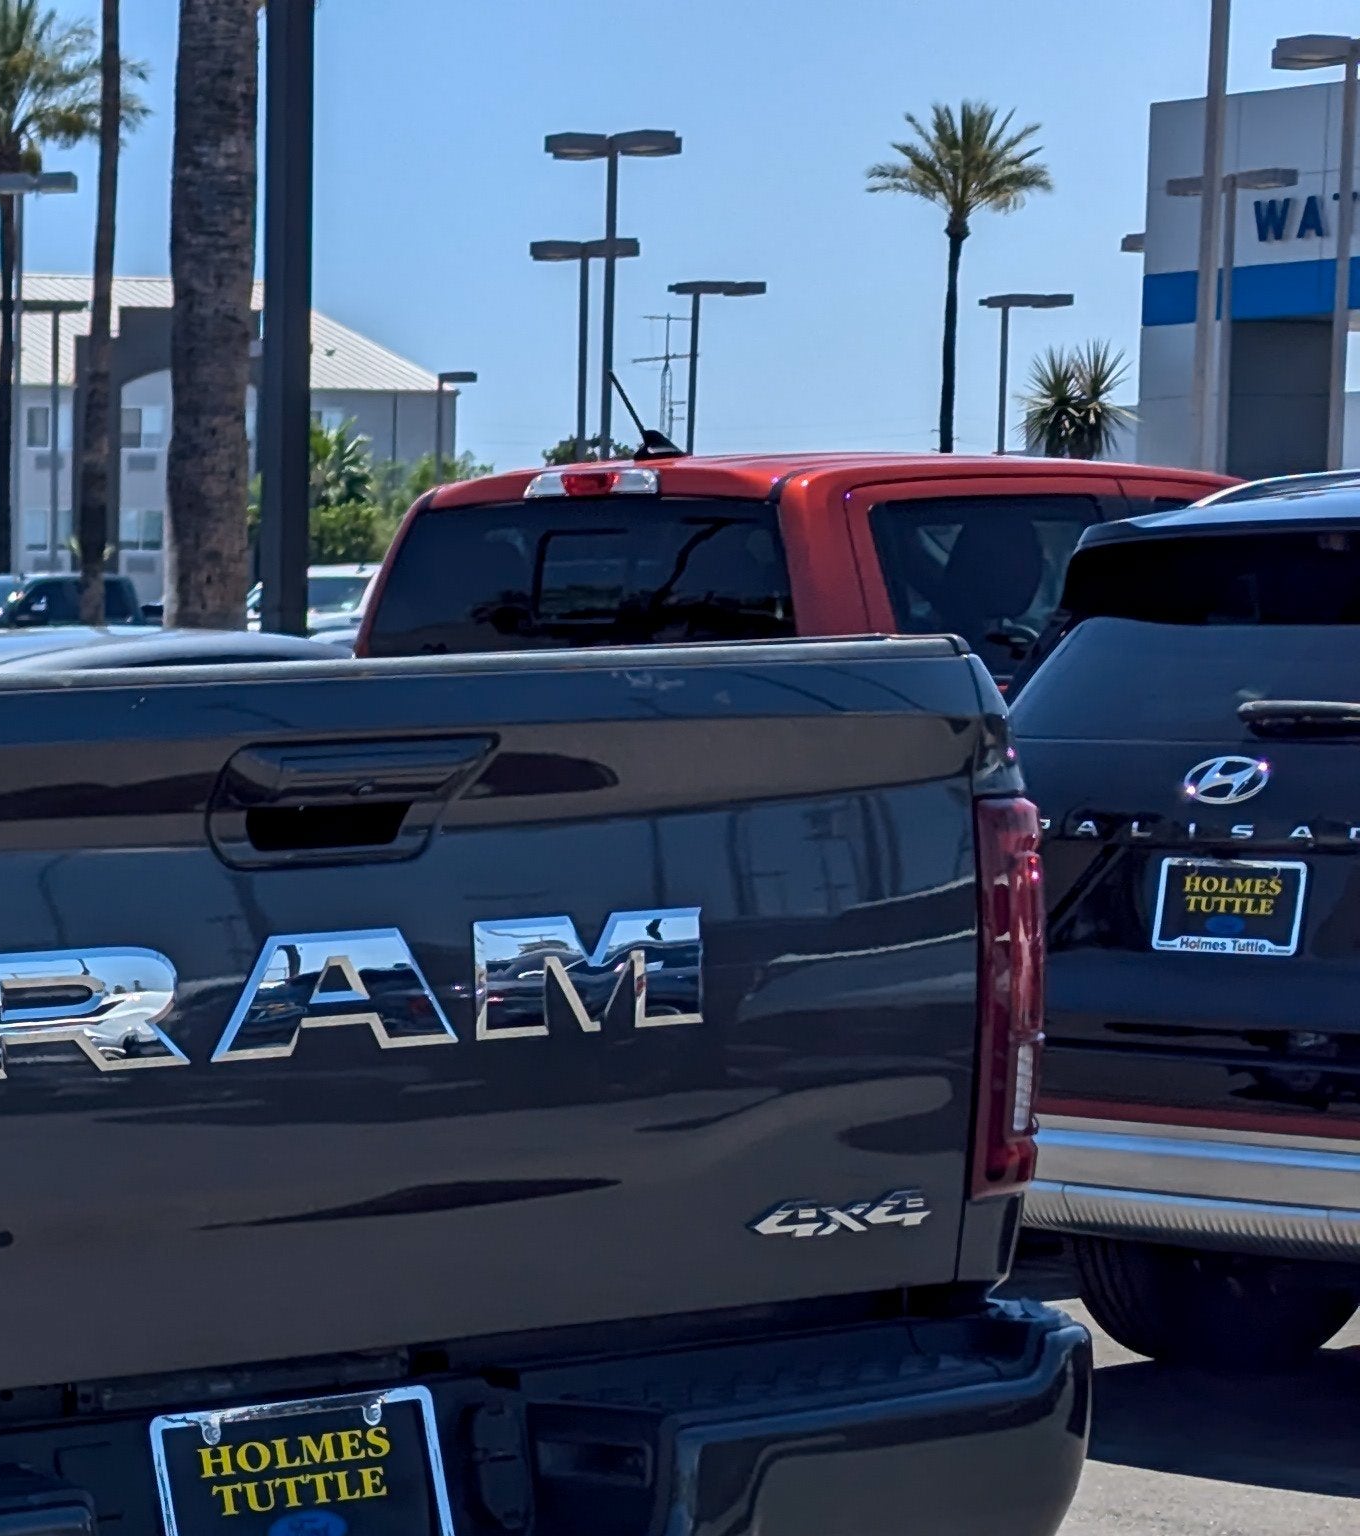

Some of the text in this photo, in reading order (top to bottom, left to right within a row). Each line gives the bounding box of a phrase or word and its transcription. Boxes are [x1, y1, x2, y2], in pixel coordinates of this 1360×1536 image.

[1254, 192, 1359, 242] WA
[1184, 876, 1283, 895] HOLMES
[1185, 895, 1275, 915] TUTTLE
[1180, 937, 1227, 951] Holmes
[1231, 939, 1267, 953] Tuttle
[197, 1426, 392, 1479] HOLMES
[212, 1467, 388, 1516] TUTTLE
